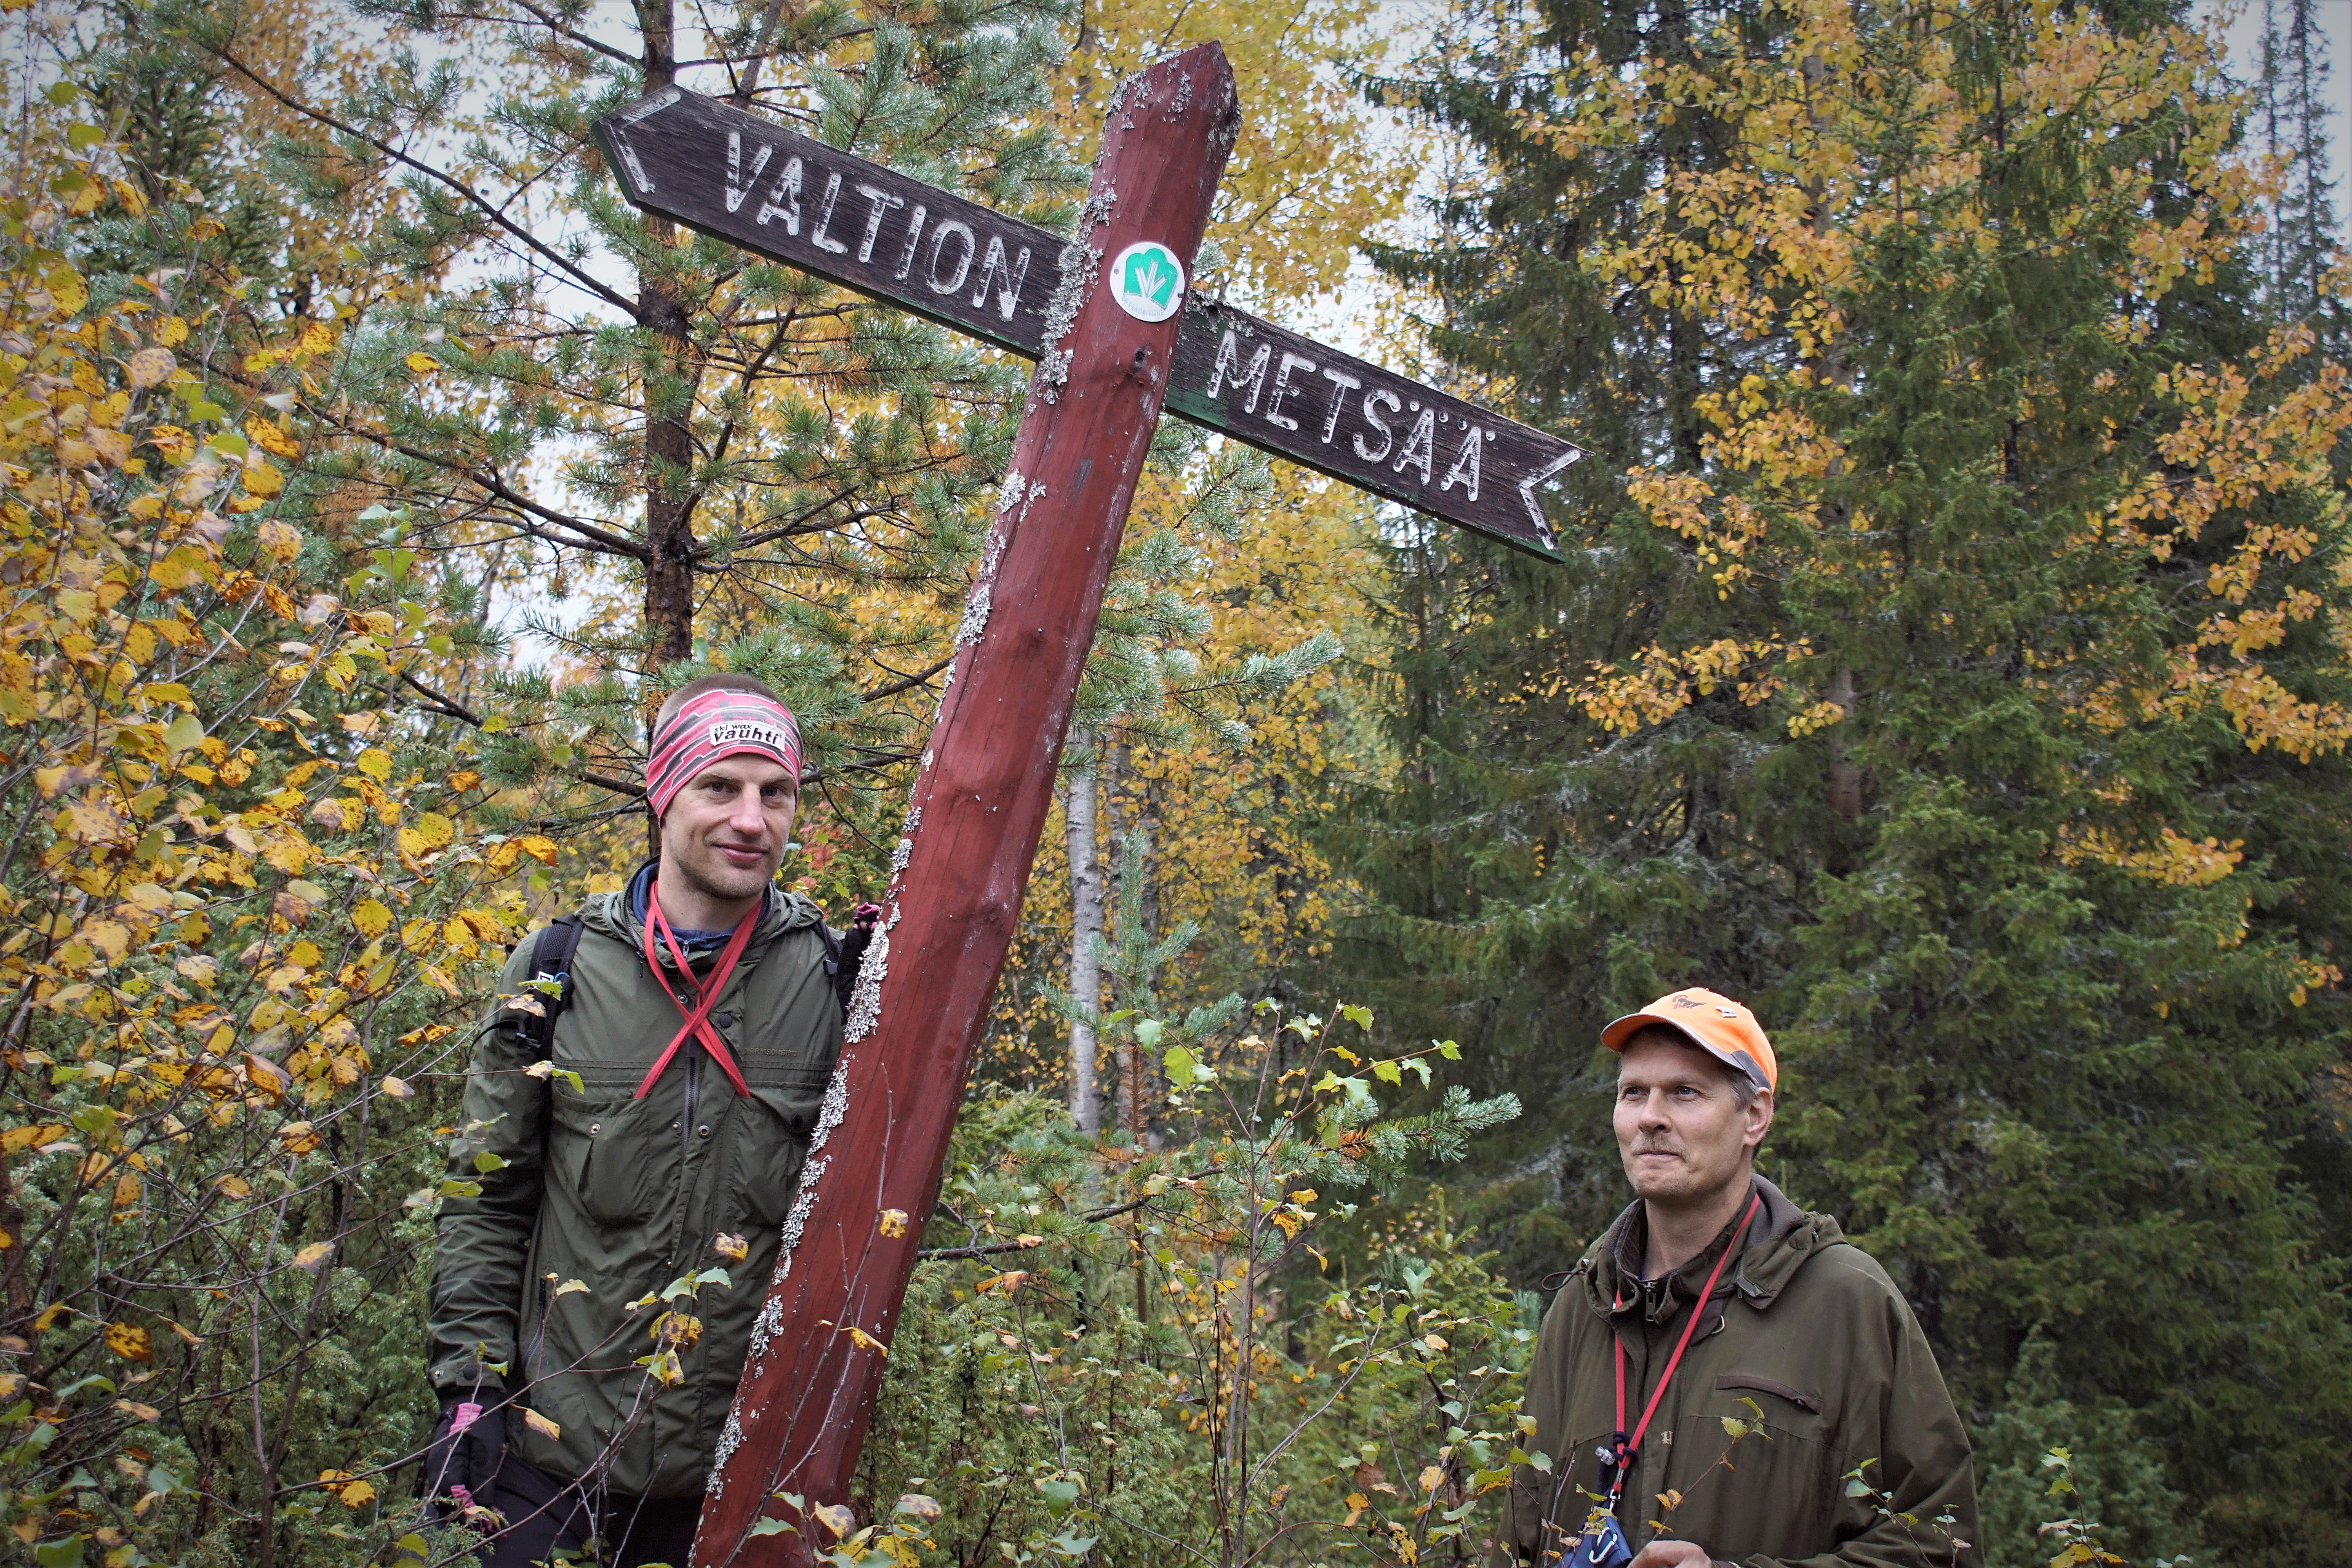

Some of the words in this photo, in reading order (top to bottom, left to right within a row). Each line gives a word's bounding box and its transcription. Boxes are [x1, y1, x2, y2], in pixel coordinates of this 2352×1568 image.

[724, 131, 1032, 322] VALTION
[1206, 328, 1497, 503] METSÄÄ
[714, 724, 728, 733] ski
[714, 727, 779, 744] vauhti
